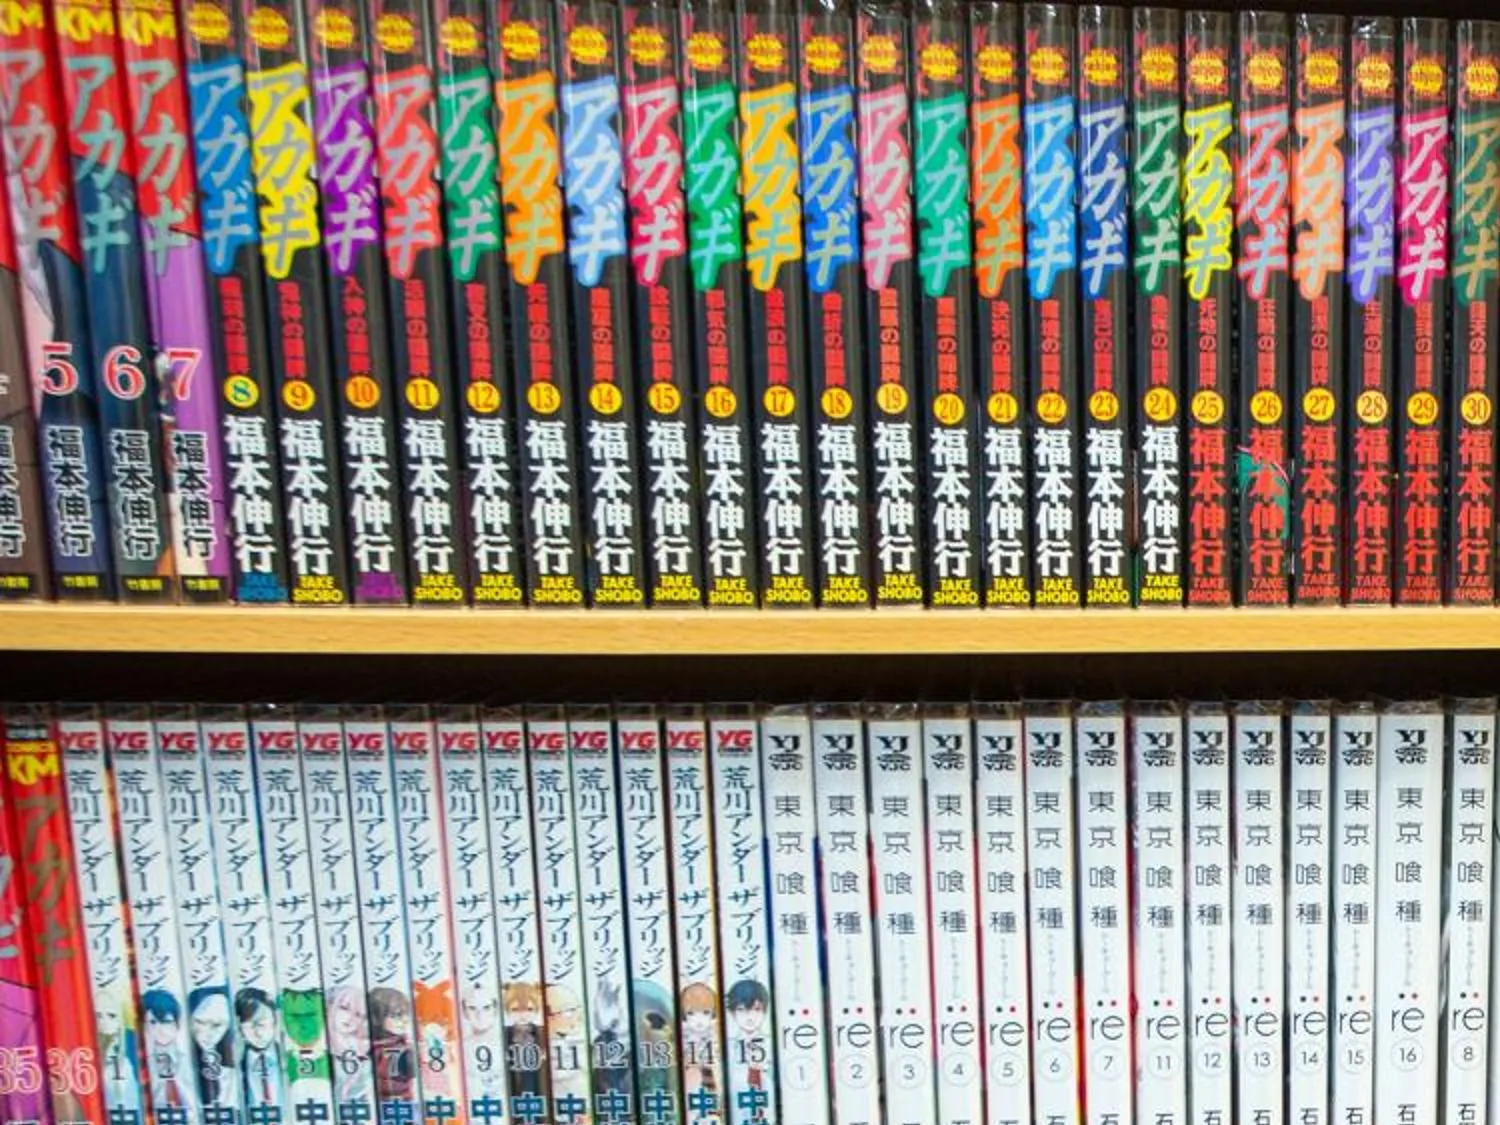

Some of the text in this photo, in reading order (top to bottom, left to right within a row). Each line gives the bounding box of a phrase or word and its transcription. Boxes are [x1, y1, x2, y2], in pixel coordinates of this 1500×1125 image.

[63, 58, 132, 272] アカギ
[130, 59, 194, 275] アカギ
[191, 65, 257, 269] アカギ
[315, 63, 377, 274] アカギ
[439, 73, 499, 277] アカギ
[564, 82, 626, 283] アカギ
[687, 86, 741, 288] アカギ
[802, 90, 859, 291] アカギ
[974, 99, 1022, 294] アカギ
[1134, 107, 1180, 293] アカギ
[1348, 110, 1393, 300] アカギ
[40, 342, 77, 395] 5
[103, 347, 145, 399] 6
[166, 349, 200, 400] 7
[231, 379, 253, 404] 8
[351, 379, 377, 405] 10
[412, 382, 432, 406] 11
[654, 389, 675, 409] 15
[883, 389, 902, 410] 19
[1149, 394, 1171, 415] 24
[1309, 395, 1330, 415] 27
[1413, 399, 1435, 418] 29
[224, 415, 277, 573] 福本伸行
[403, 417, 453, 573] 福本伸行
[647, 420, 691, 574] 福本伸行
[817, 426, 860, 575] 福本伸行
[930, 429, 970, 576] 福本伸行
[1141, 426, 1180, 573] 福本伸行
[1191, 429, 1227, 574] 福本伸行
[1405, 429, 1440, 574] 福本伸行
[294, 587, 342, 603] SHOBO
[299, 575, 334, 588] TAKE
[118, 767, 160, 892] 荒川アンダー
[724, 766, 763, 887] 荒川アンダー
[773, 795, 810, 935] 東京喰種
[987, 795, 1017, 933] 東京喰種
[1088, 791, 1117, 928] 東京喰種
[1396, 787, 1423, 923] 東京喰種
[48, 1047, 98, 1094] 36
[300, 1050, 315, 1076] 5
[475, 1045, 493, 1071] 9
[737, 1039, 768, 1065] 15
[851, 1062, 863, 1079] 2
[1103, 1055, 1114, 1071] 7
[1203, 1052, 1222, 1070] 12
[1398, 1047, 1417, 1064] 16
